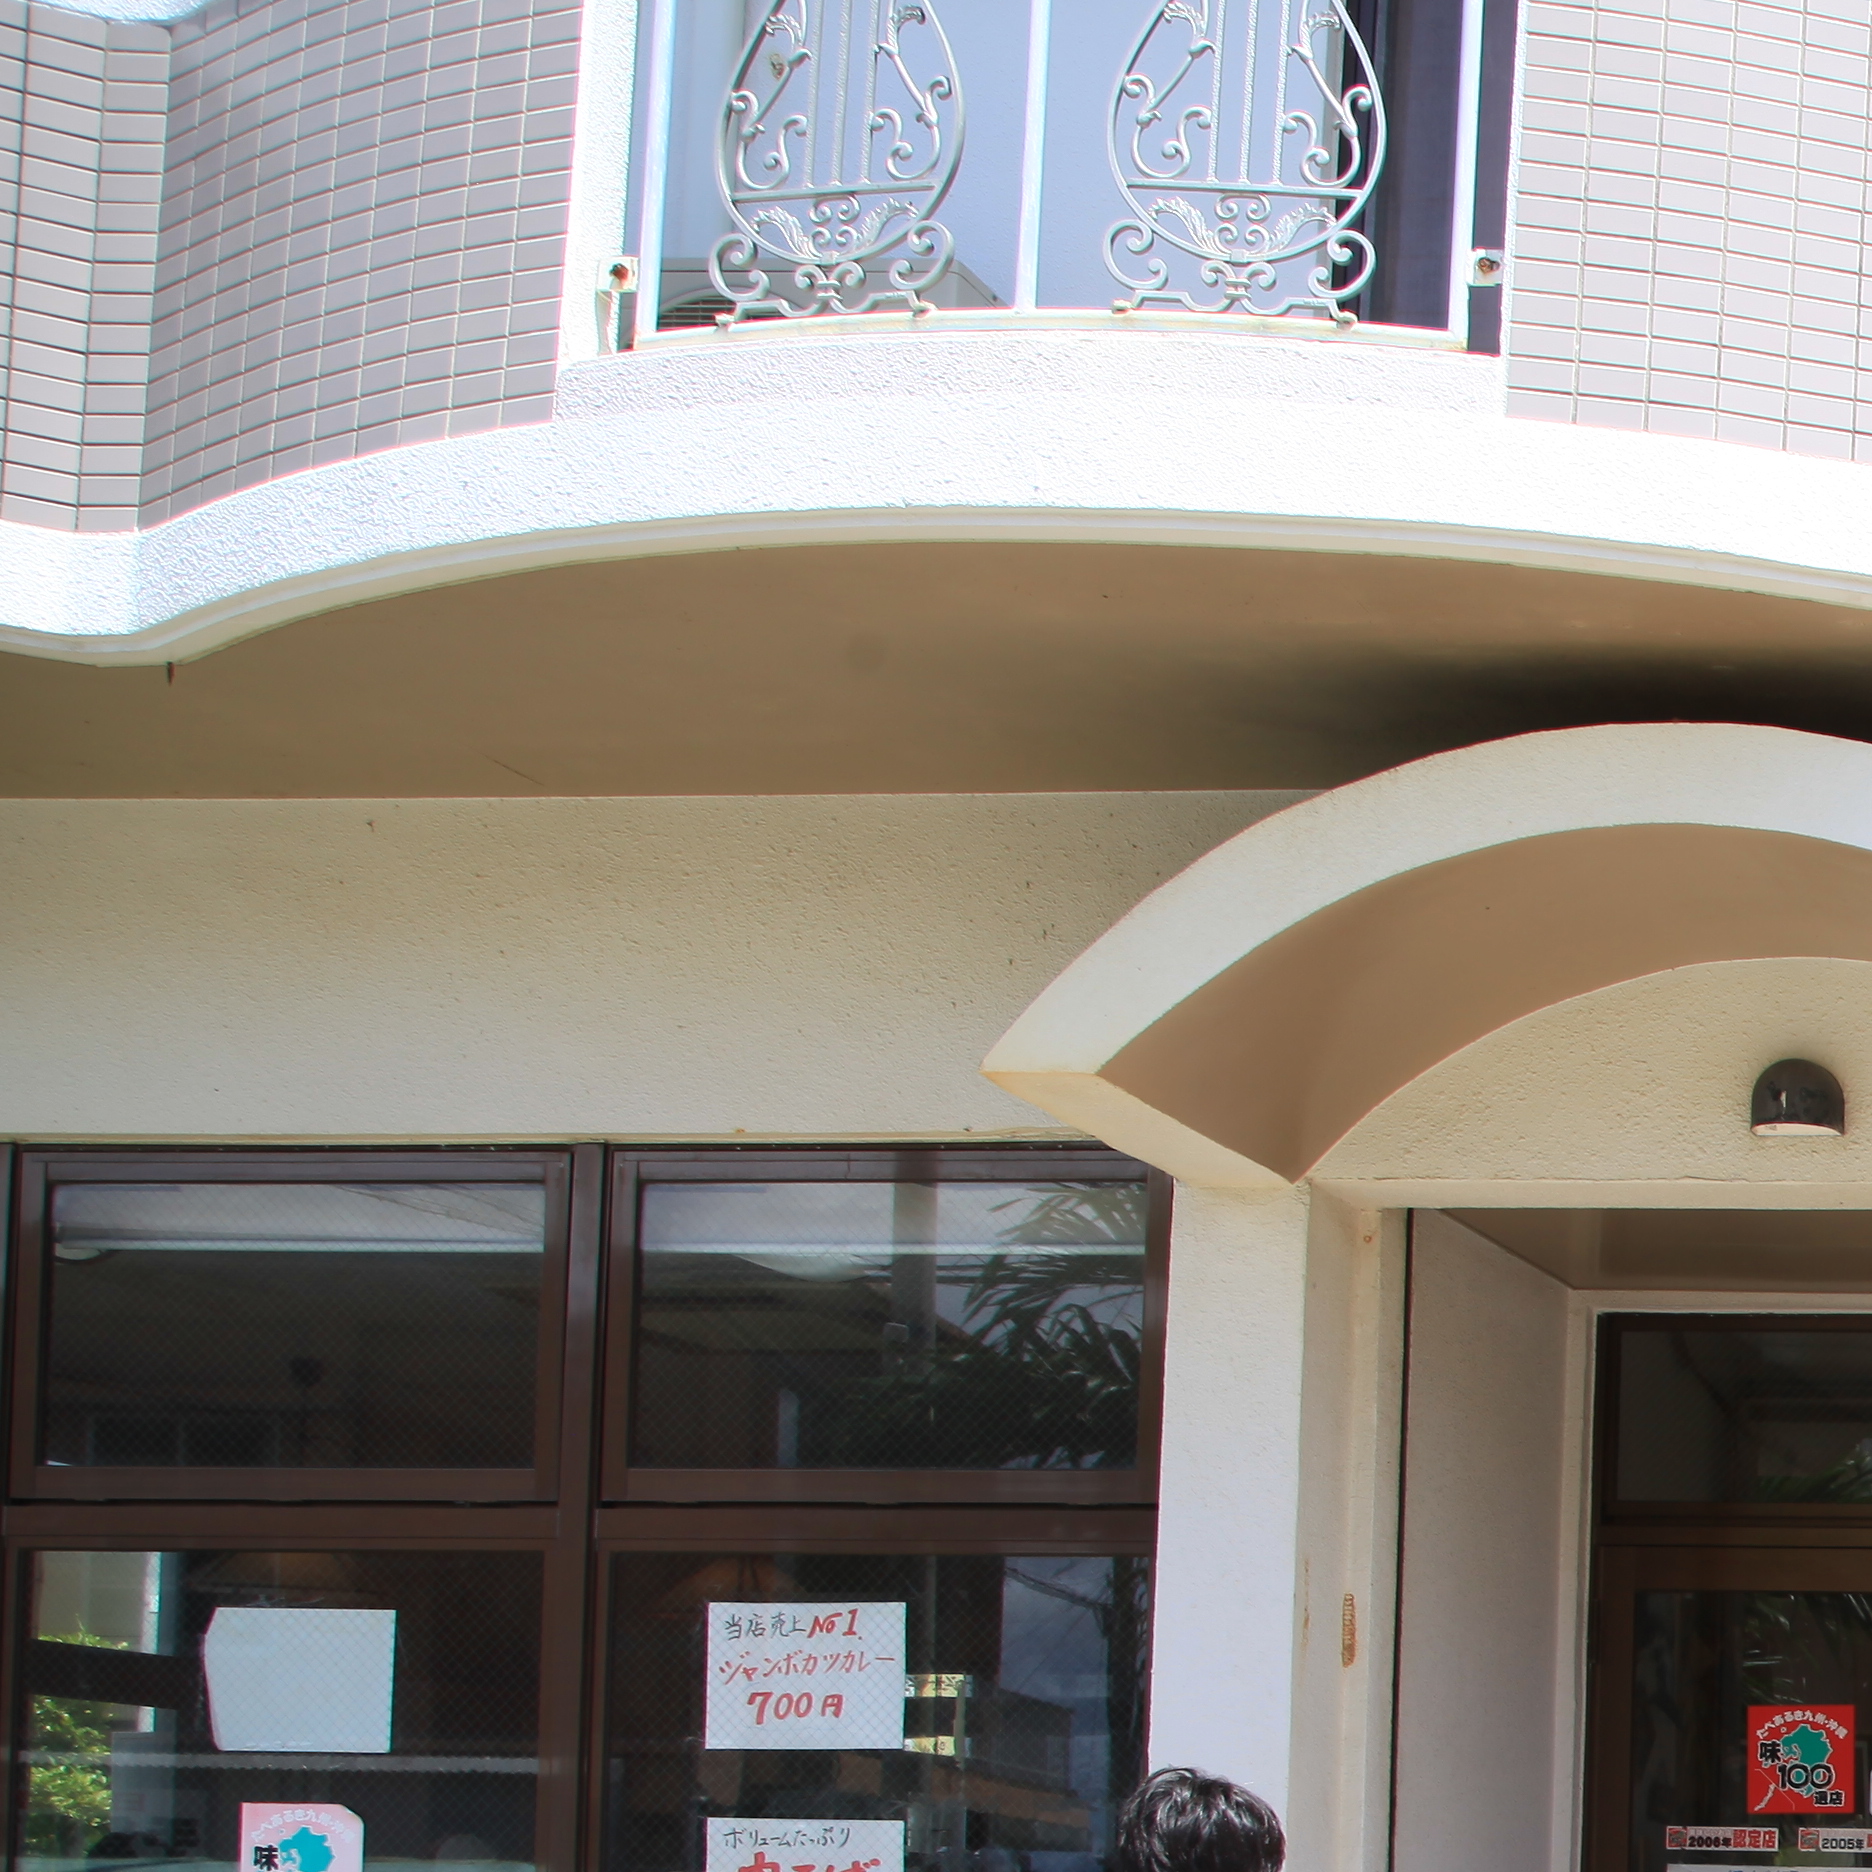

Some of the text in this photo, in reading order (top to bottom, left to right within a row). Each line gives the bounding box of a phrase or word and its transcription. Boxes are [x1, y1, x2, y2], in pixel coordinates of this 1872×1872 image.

[718, 1650, 896, 1685] ジャンボカツカレー
[747, 1691, 844, 1725] 700円
[1758, 1740, 1782, 1763] 味
[1777, 1762, 1835, 1791] 100
[723, 1827, 851, 1849] ボリュームたっぷり
[253, 1844, 279, 1872] 味
